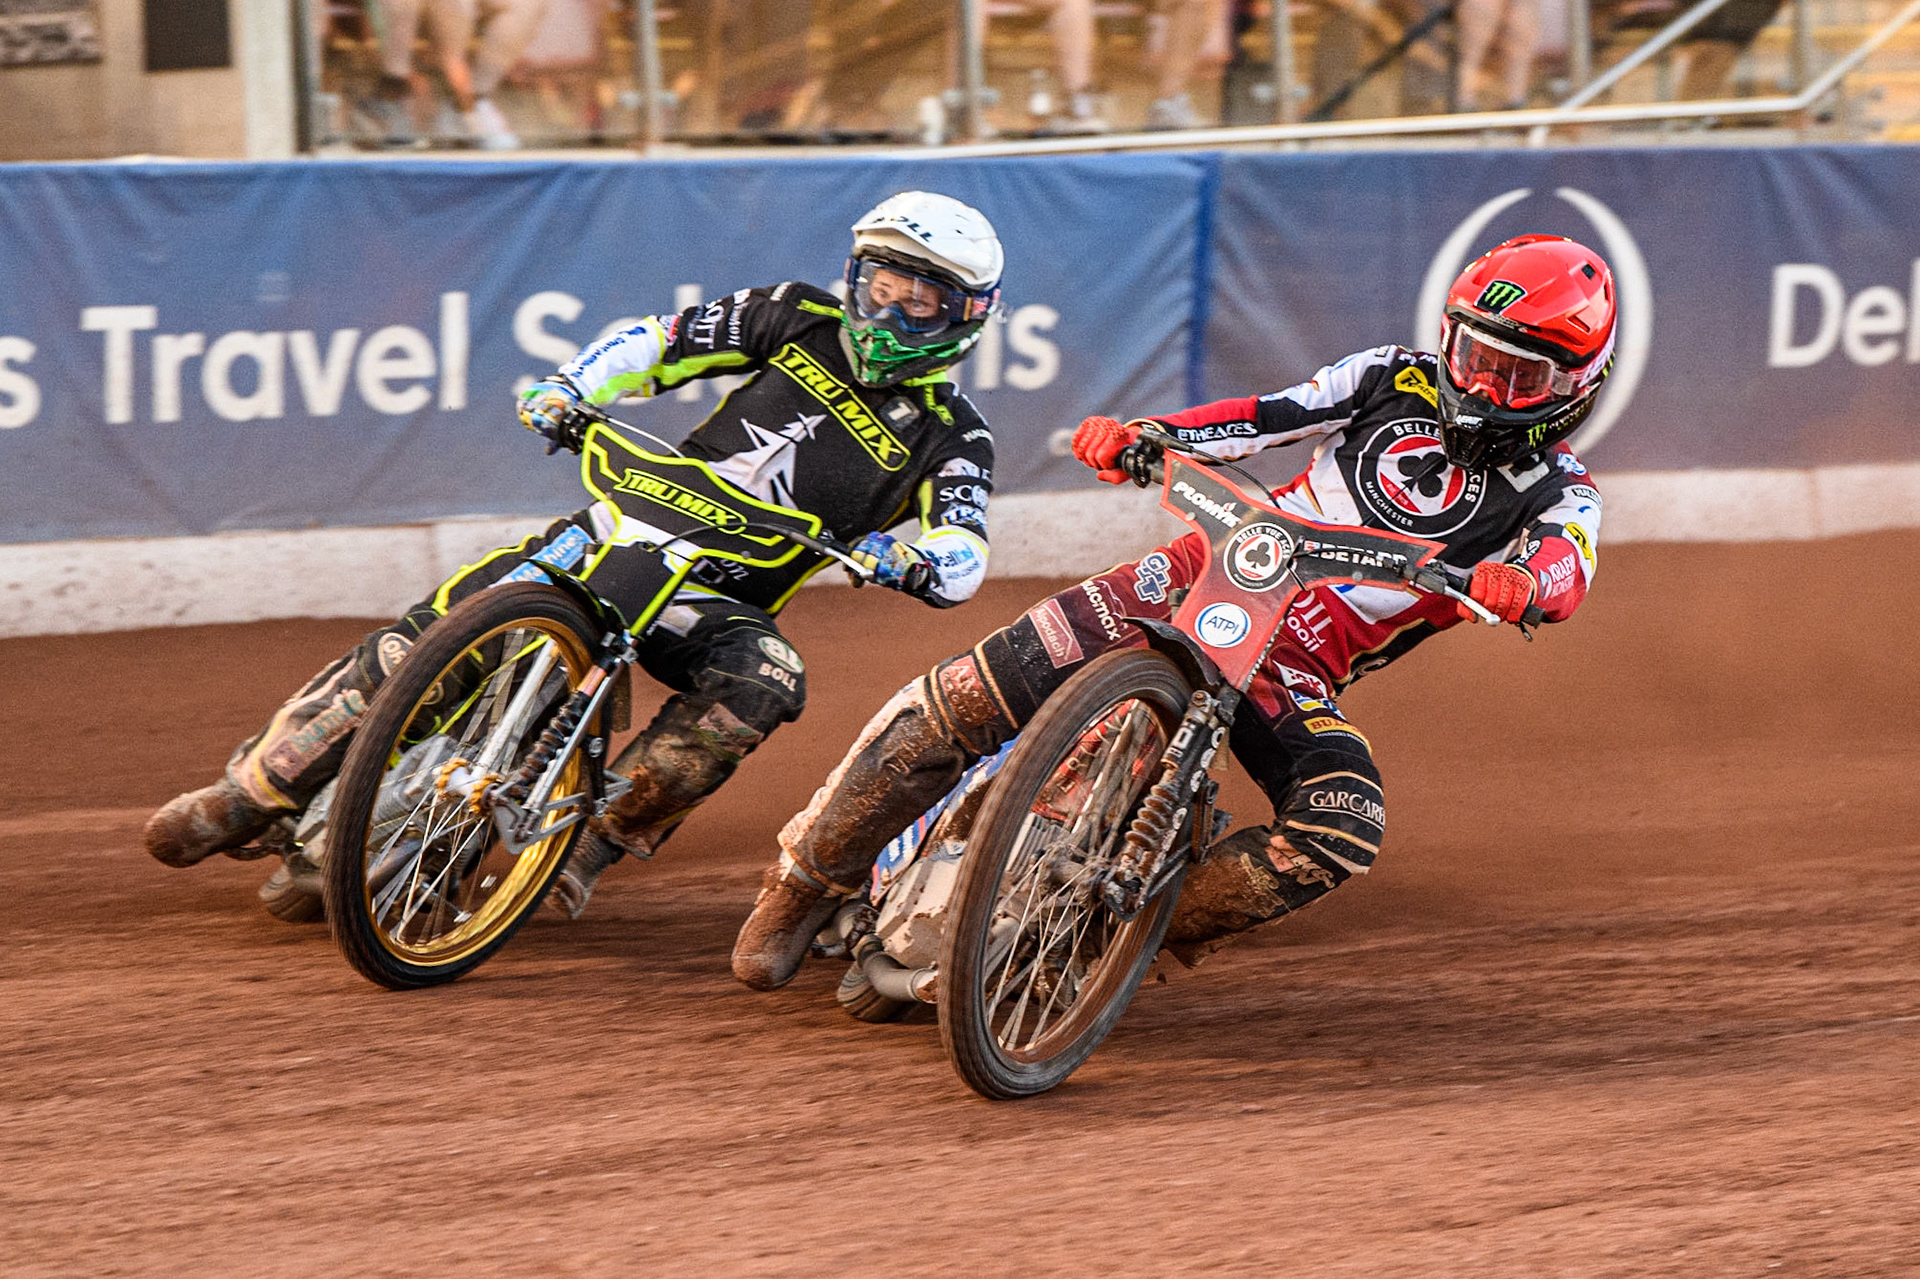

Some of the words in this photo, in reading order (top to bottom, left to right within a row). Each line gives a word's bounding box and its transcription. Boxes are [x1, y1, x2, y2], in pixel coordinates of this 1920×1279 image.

[81, 291, 470, 424] Travel
[783, 351, 845, 400] TRU
[835, 400, 903, 461] MIX
[1392, 422, 1441, 437] BELLE
[627, 474, 680, 501] TRU
[673, 492, 737, 526] MIX
[1365, 480, 1414, 528] MANCHESTER
[1205, 615, 1240, 635] ATPI
[758, 662, 797, 692] BOLL
